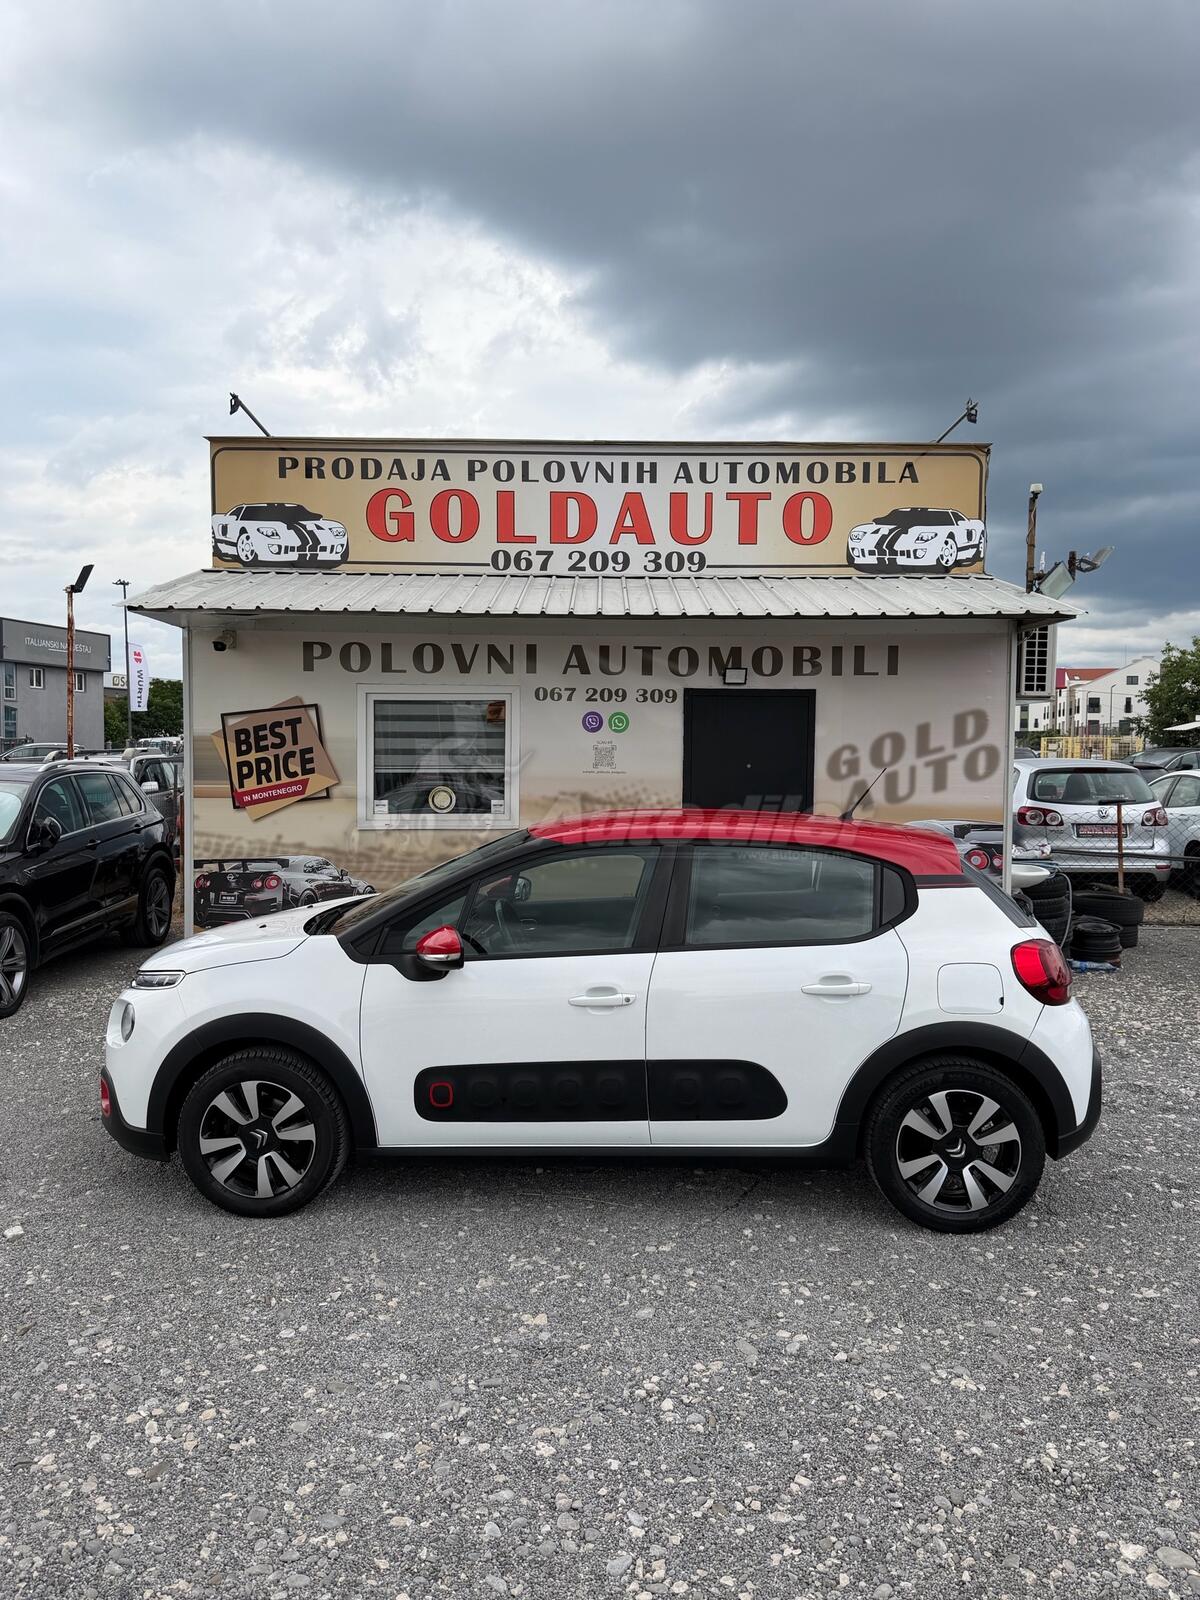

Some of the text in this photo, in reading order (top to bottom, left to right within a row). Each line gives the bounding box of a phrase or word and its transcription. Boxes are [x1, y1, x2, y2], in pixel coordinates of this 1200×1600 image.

[277, 456, 920, 484] PRODAJA POLOVNIH AUTOMOBILA
[365, 487, 833, 545] GOLDAUTO
[489, 549, 708, 573] 067 209 309
[302, 640, 900, 678] POLOVNI AUTOMOBILI
[534, 686, 678, 704] 067 209 309
[234, 716, 302, 757] BEST
[826, 708, 990, 782] GOLD
[236, 746, 316, 789] PRICE
[843, 744, 1001, 811] AUTO
[252, 784, 303, 800] MONTENEGRO
